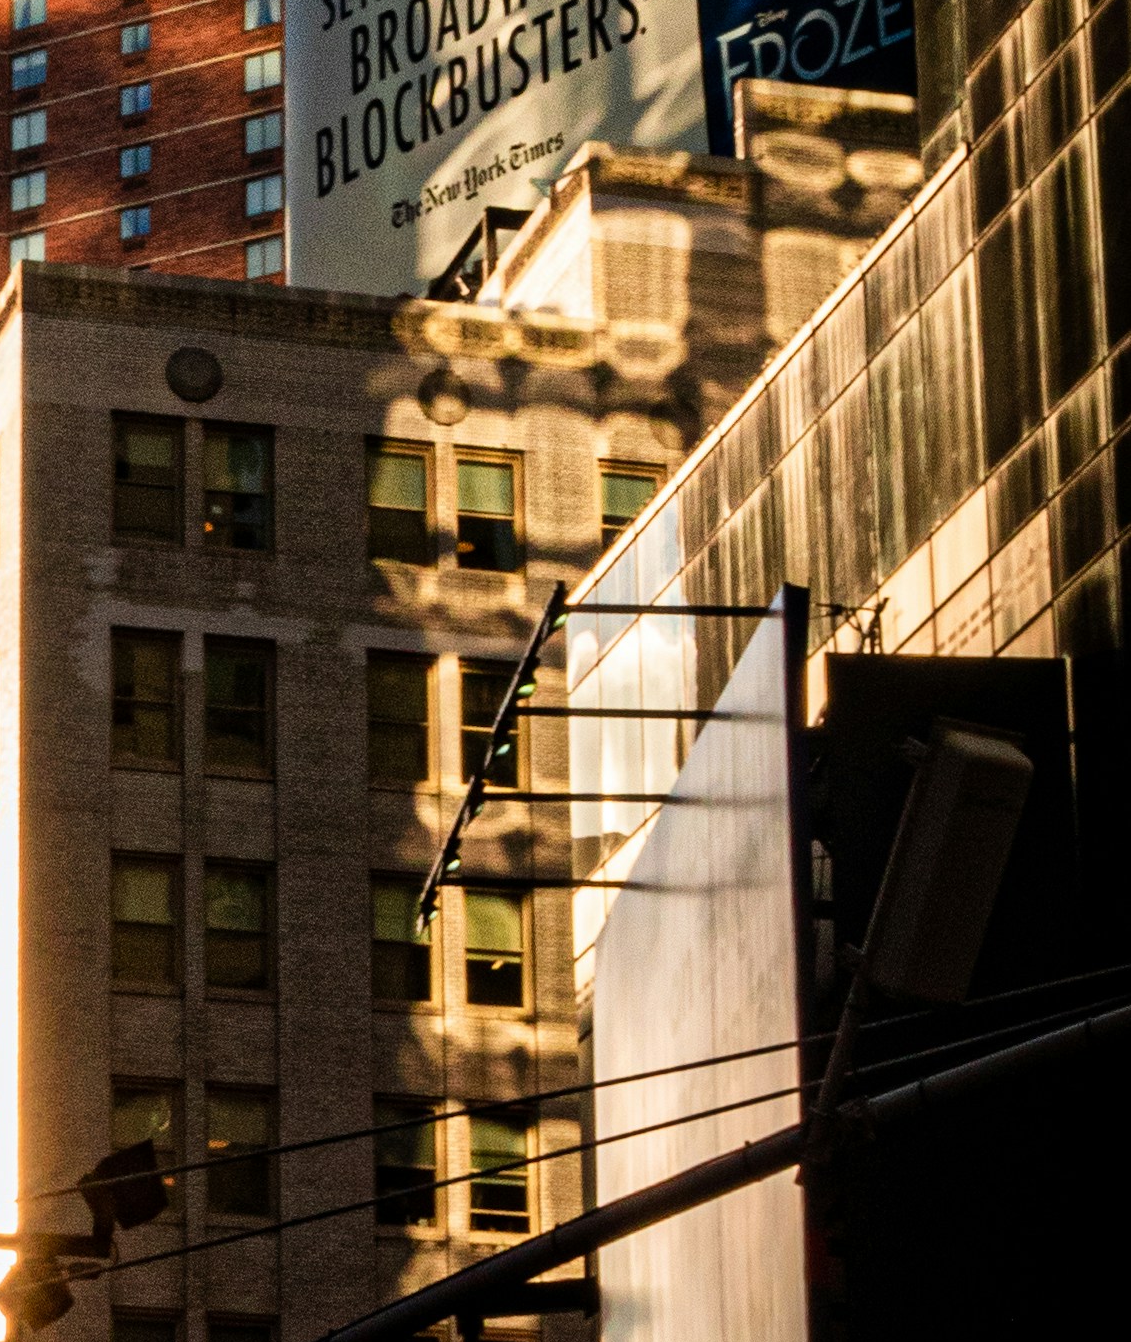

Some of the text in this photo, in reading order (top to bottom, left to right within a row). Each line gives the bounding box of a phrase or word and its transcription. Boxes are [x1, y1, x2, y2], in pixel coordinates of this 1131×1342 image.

[391, 131, 566, 230] The New York Times
